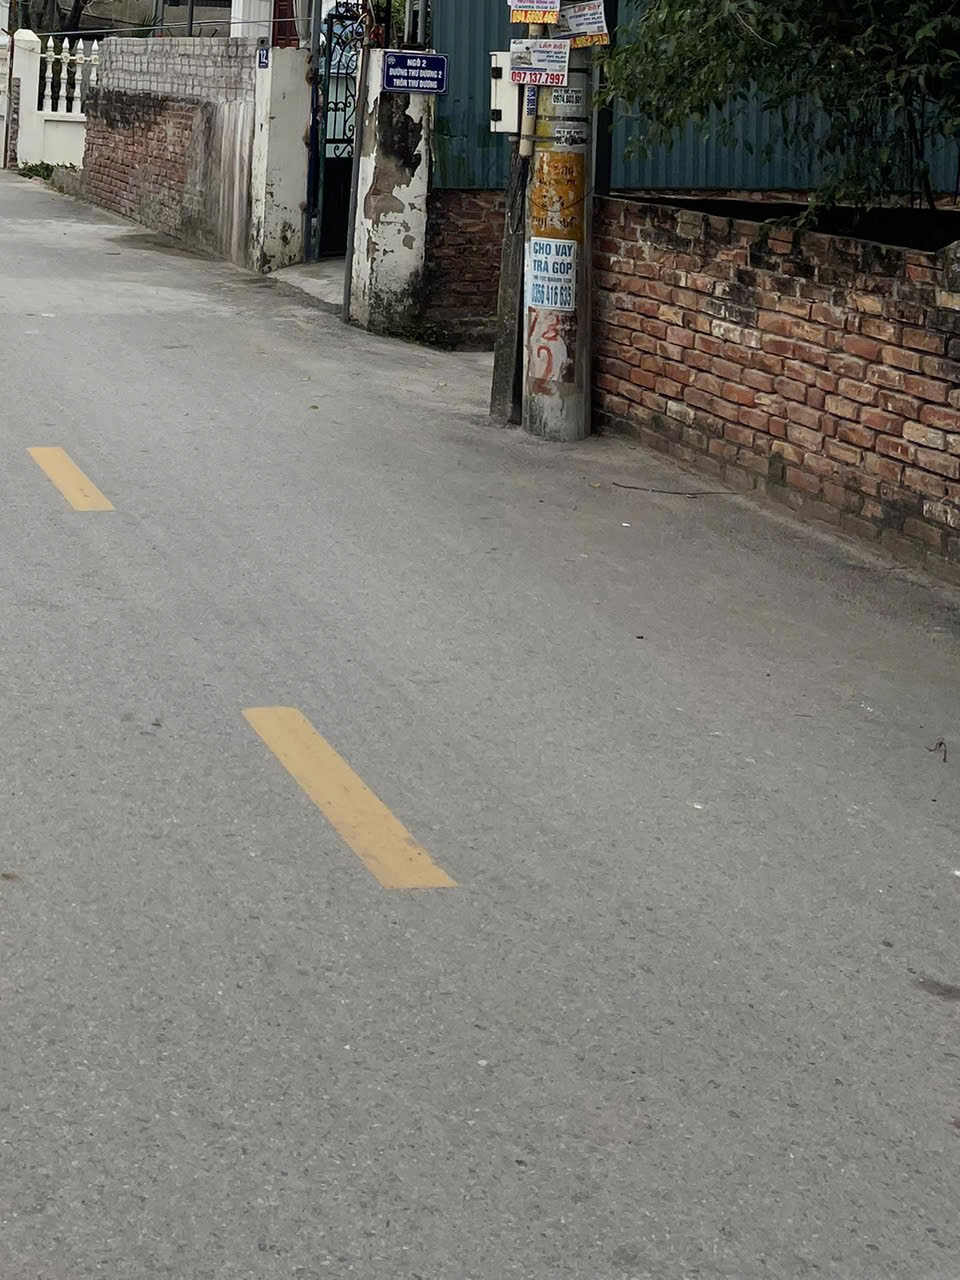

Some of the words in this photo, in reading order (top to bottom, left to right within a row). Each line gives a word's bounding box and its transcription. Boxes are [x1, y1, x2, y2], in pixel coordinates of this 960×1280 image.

[511, 71, 565, 85] 097.137.7997
[533, 242, 552, 255] CHO
[555, 244, 573, 257] VAY
[533, 257, 549, 273] TRẢ
[552, 260, 572, 274] GÓP
[546, 285, 559, 305] 416
